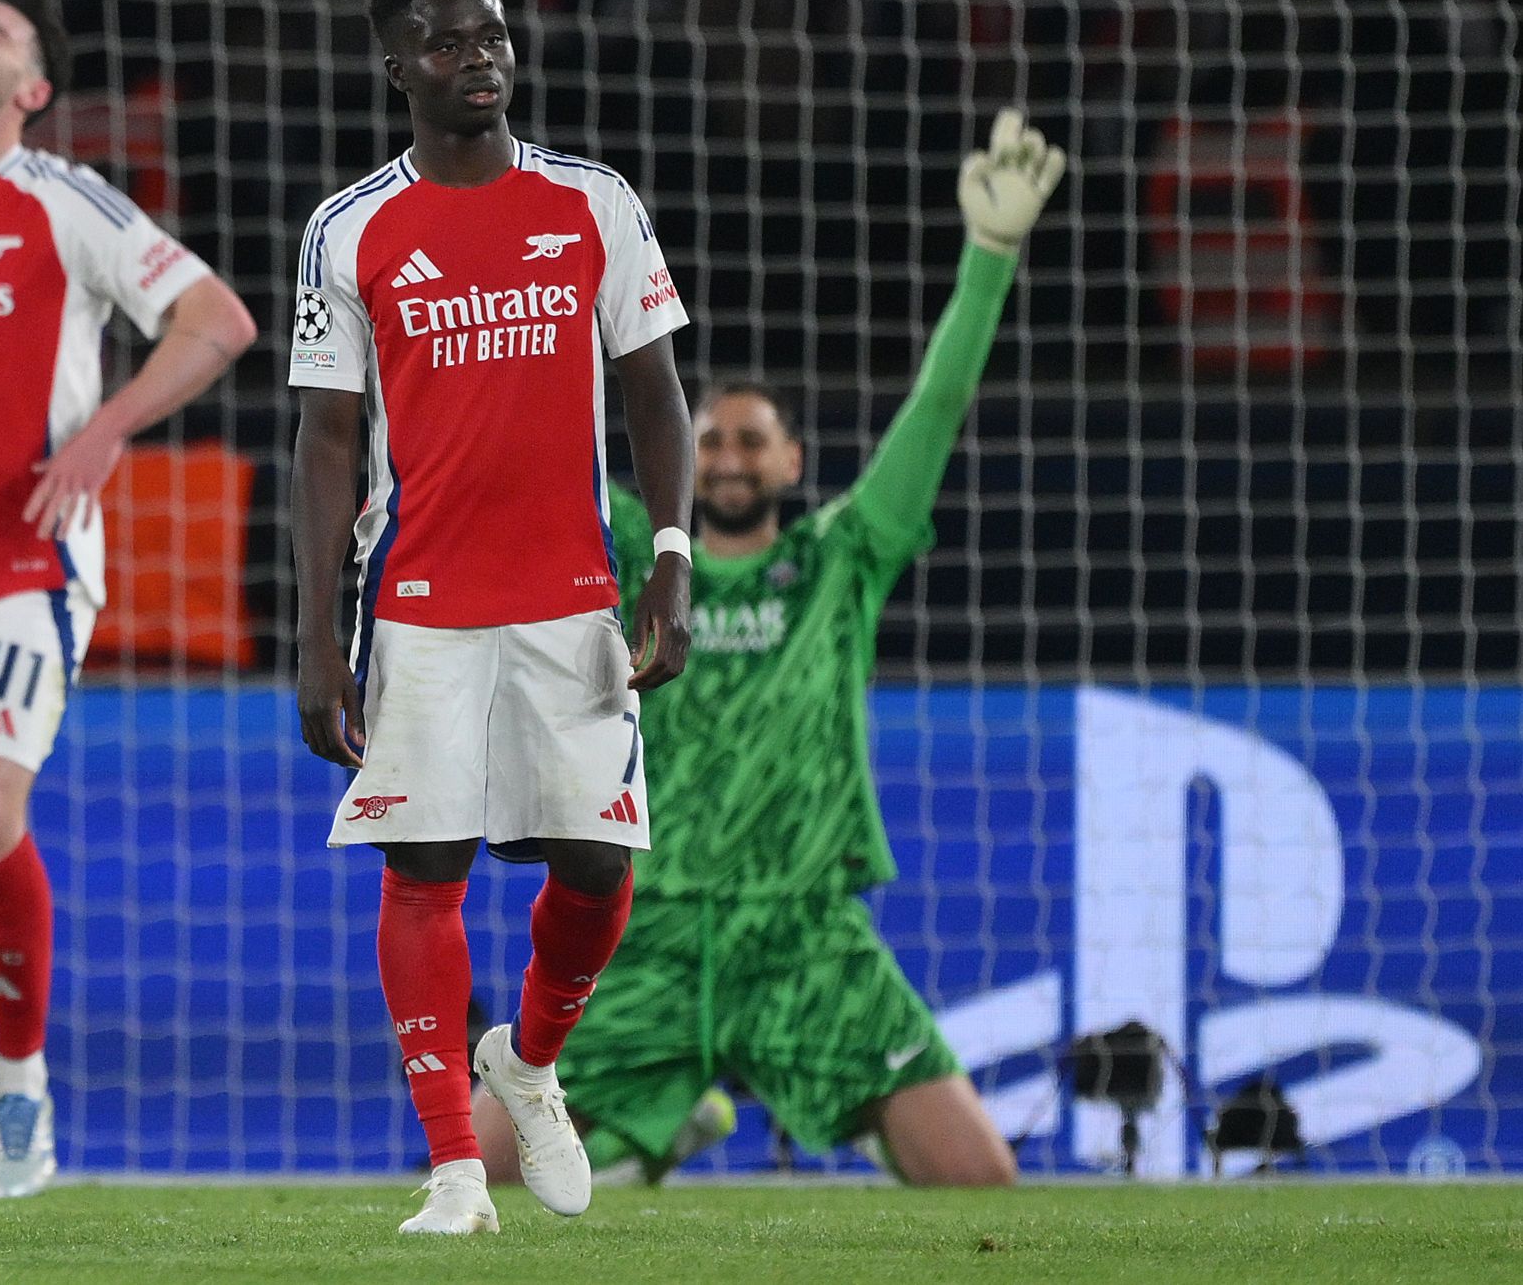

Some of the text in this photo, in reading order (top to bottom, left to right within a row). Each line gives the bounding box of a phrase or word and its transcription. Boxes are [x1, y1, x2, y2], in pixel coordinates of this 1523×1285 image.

[397, 280, 579, 338] Emirates
[432, 323, 557, 369] FLY BETTER
[621, 710, 639, 785] 7
[396, 1015, 437, 1036] AFC
